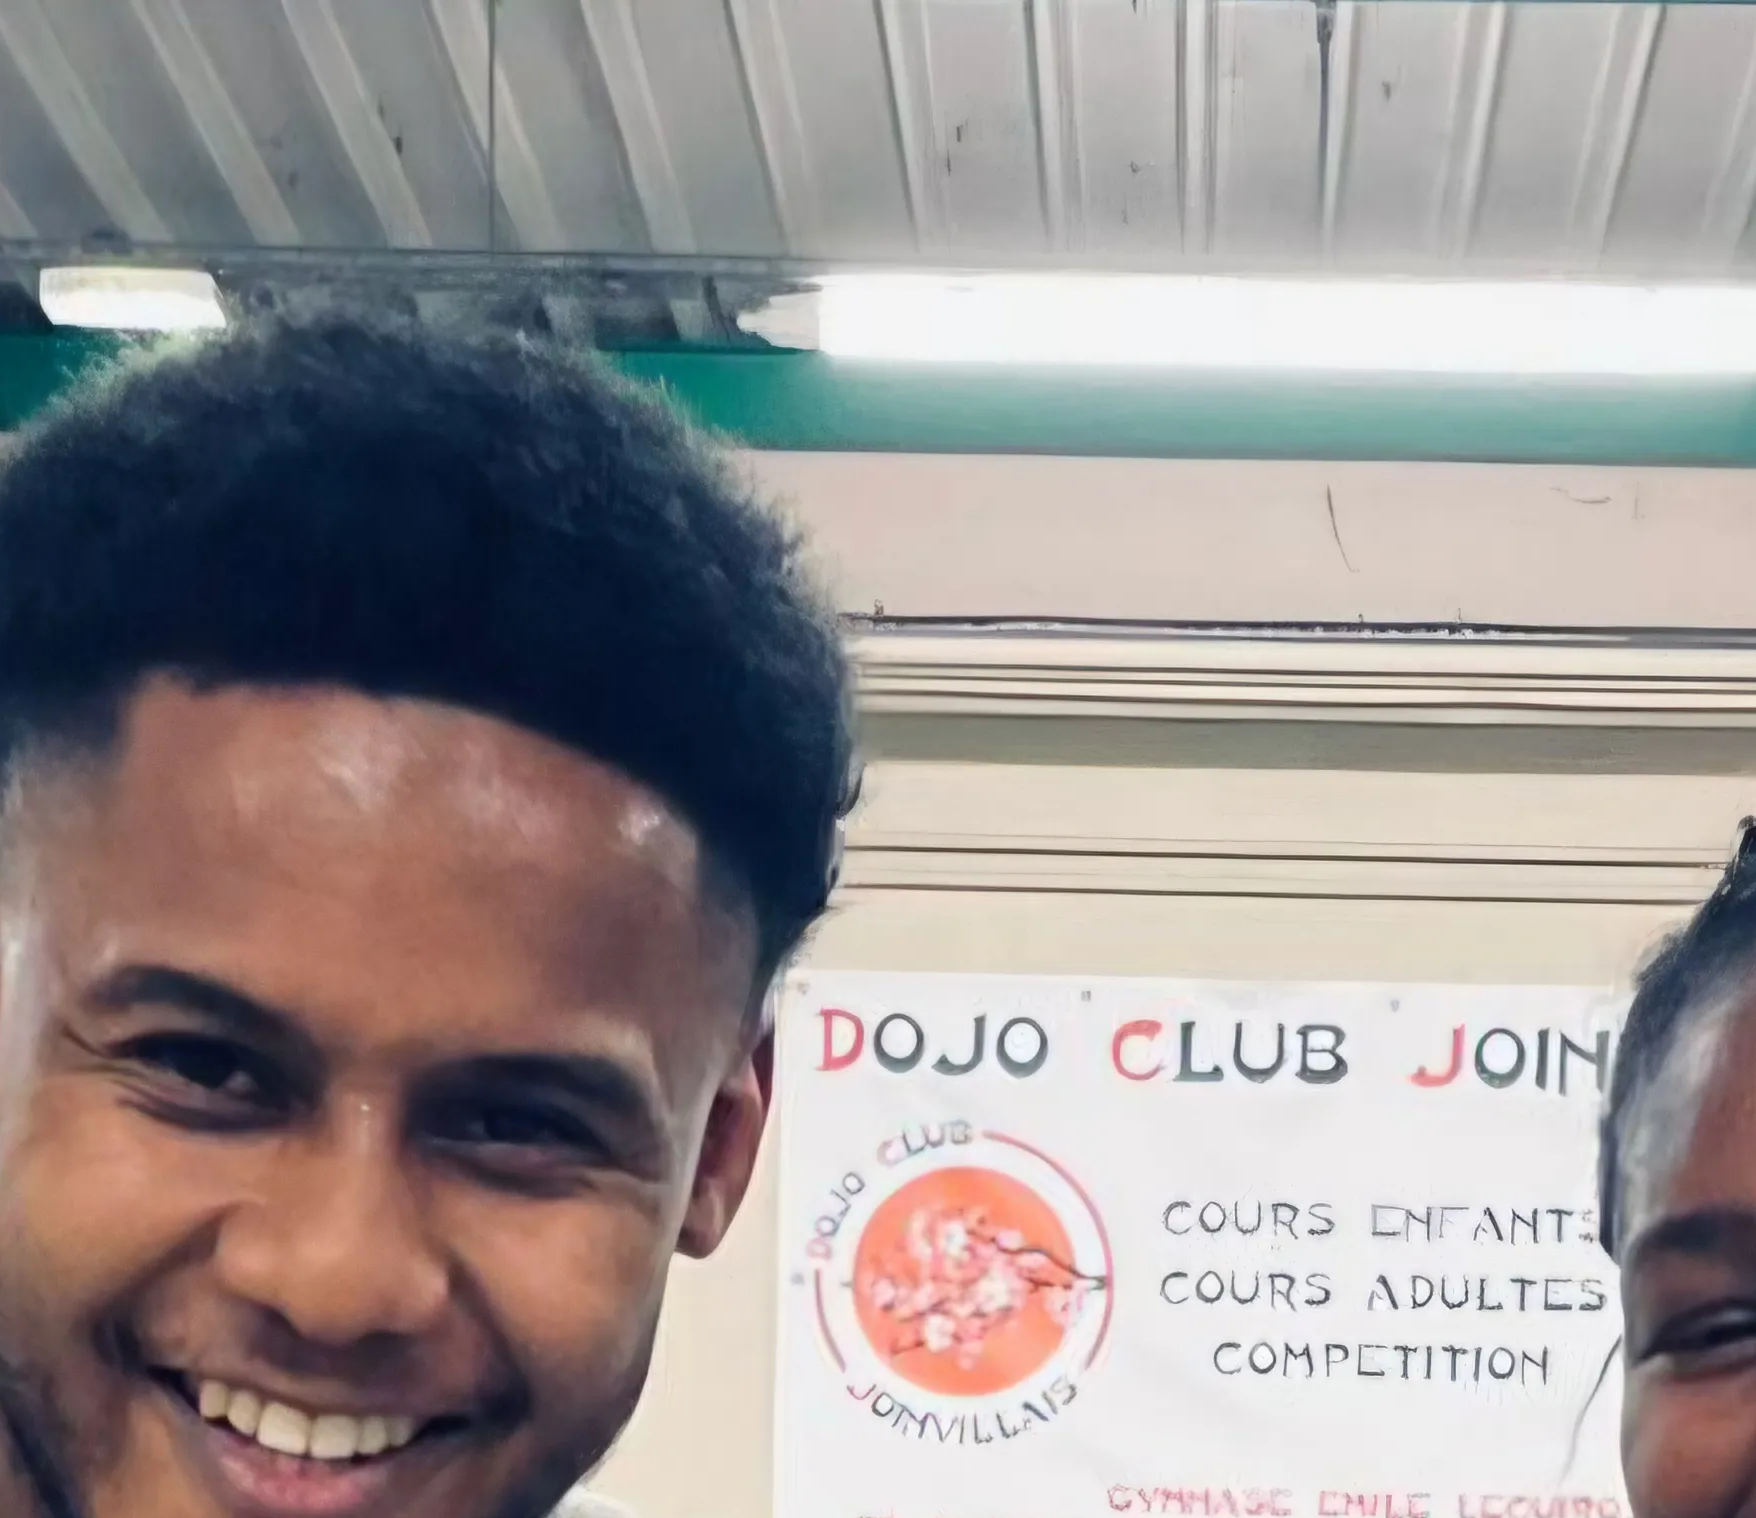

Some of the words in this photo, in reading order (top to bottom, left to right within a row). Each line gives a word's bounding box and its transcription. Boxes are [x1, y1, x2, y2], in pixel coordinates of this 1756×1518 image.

[815, 1008, 1050, 1080] DOJO
[1110, 1018, 1350, 1085] CLUB
[806, 1171, 866, 1260] DOJO
[877, 1120, 974, 1166] CLUB
[1161, 1200, 1337, 1241] COURS
[1158, 1269, 1333, 1312] COURS
[1366, 1273, 1609, 1313] ADULTES
[1212, 1340, 1550, 1387] COMPETITION
[846, 1374, 1078, 1445] JOINVILLAIS
[1106, 1484, 1292, 1517] GYMNASE
